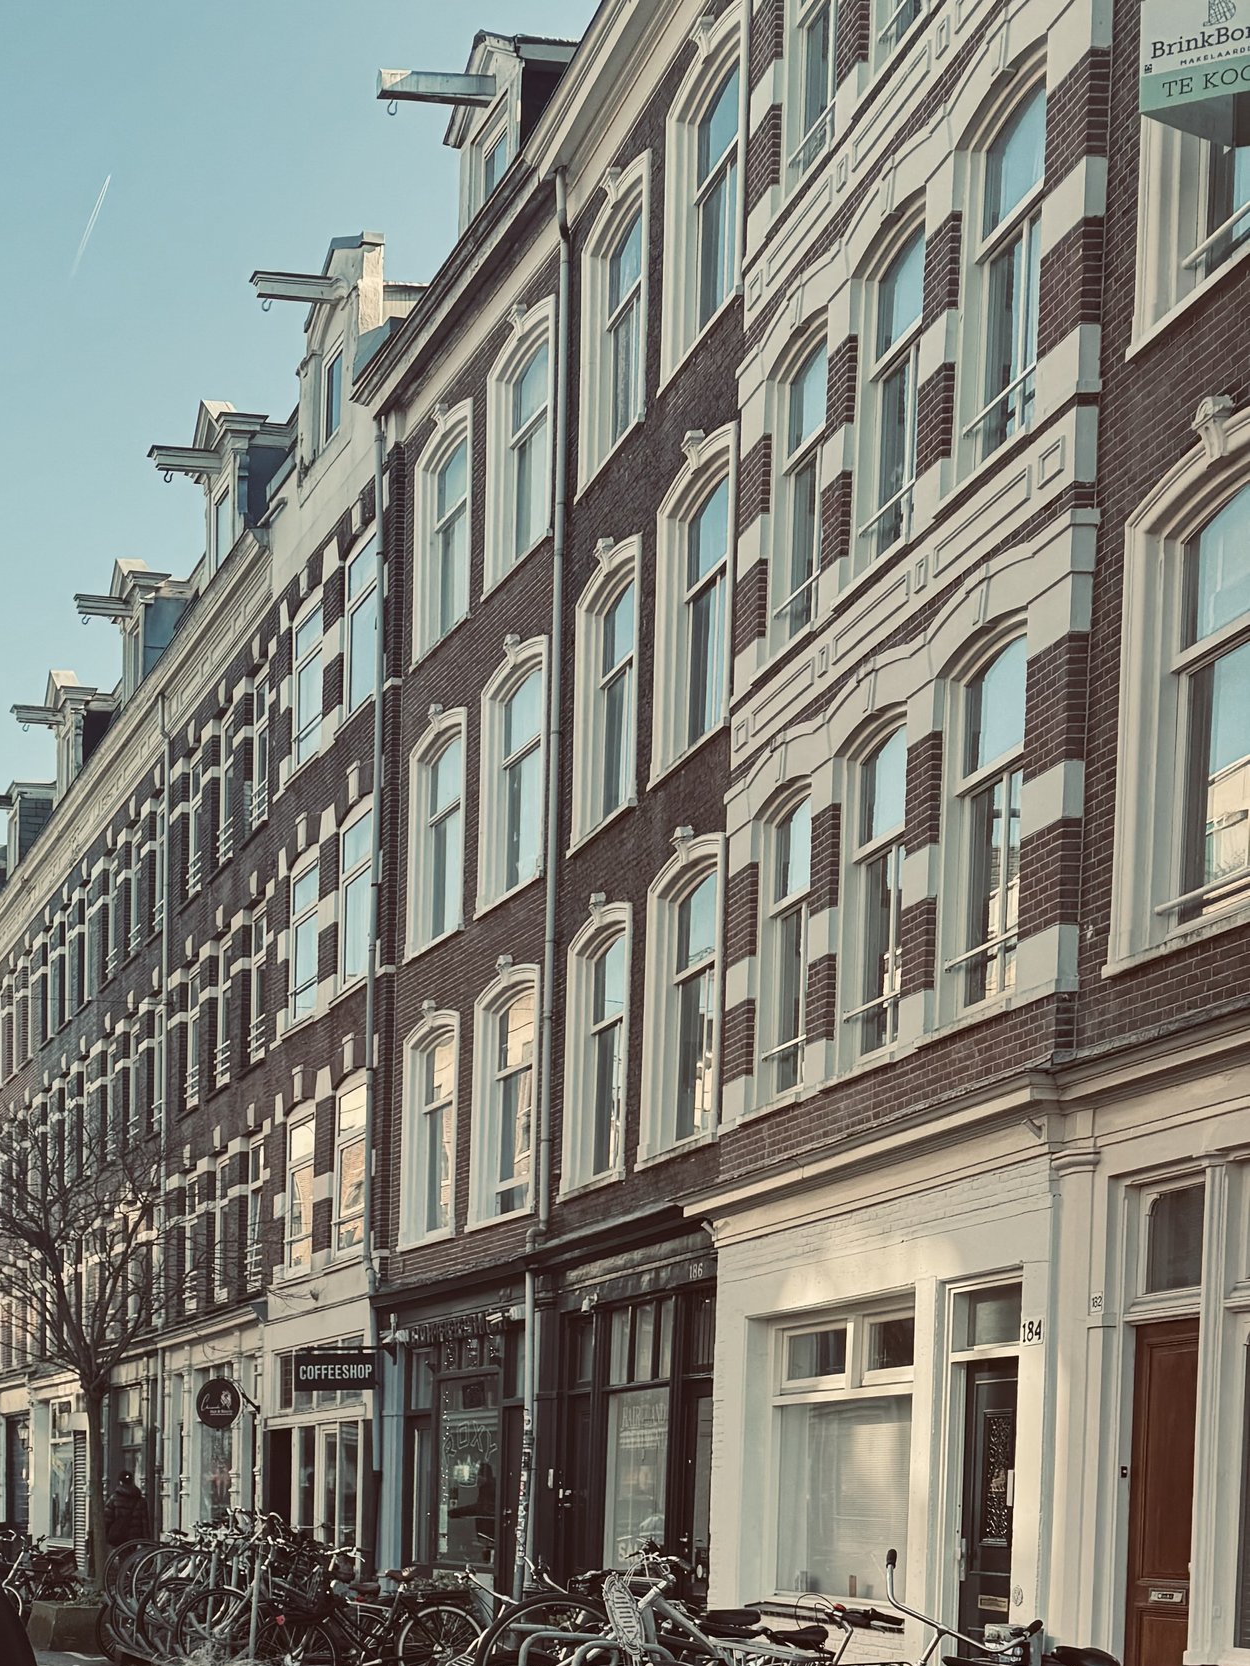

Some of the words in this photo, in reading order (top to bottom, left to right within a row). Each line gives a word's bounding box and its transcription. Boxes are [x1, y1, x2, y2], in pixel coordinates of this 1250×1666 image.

[1162, 77, 1193, 98] TE
[689, 1263, 703, 1279] 186
[1022, 1319, 1042, 1343] 184
[299, 1364, 372, 1380] COFFEESHOP
